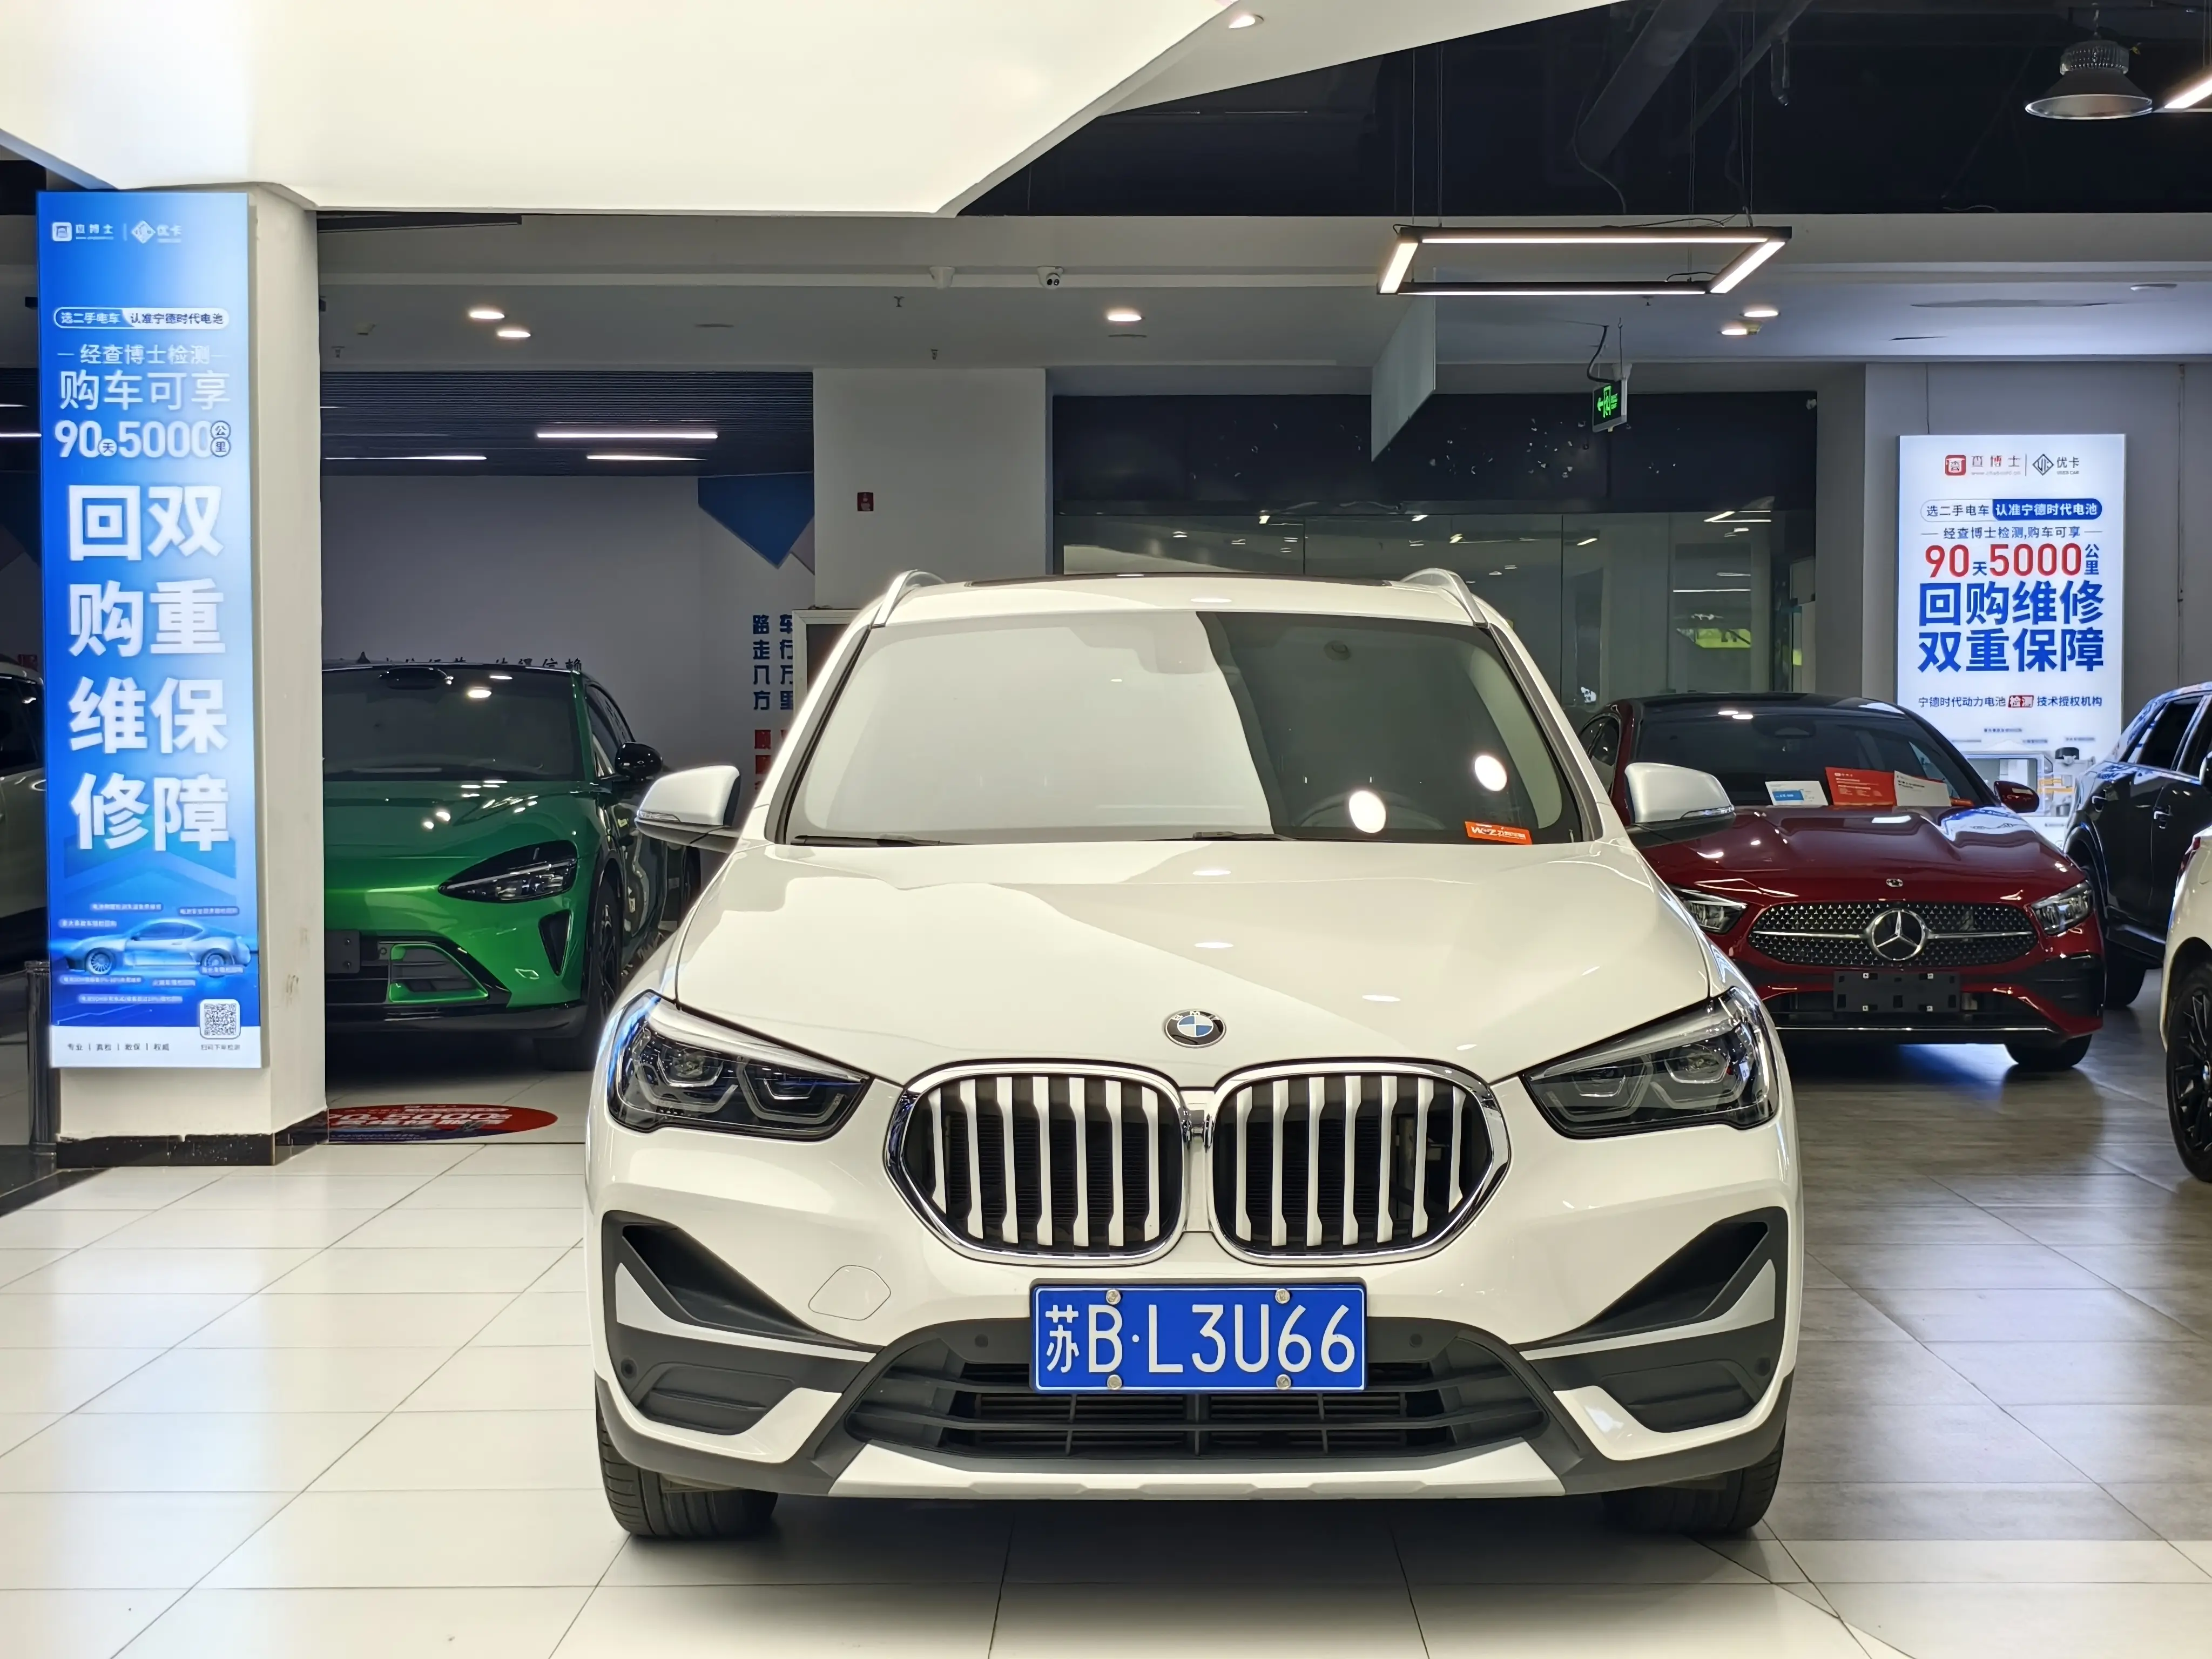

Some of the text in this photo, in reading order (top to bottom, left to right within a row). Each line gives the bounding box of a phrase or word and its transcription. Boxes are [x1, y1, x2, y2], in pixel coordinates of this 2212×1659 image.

[80, 343, 210, 365] 经查博士检测
[59, 369, 231, 410] 购车可享
[2056, 456, 2080, 468] 优卡
[1926, 503, 2098, 517] 选二手电车 认准宁德时代电池
[1919, 580, 2104, 626] 回购维修
[1917, 627, 2104, 673] 双重保障
[1918, 696, 2006, 708] 宁德时代动力电池
[2036, 696, 2103, 707] 技术授权机构
[1045, 1304, 1355, 1373] 苏B·L3U66
